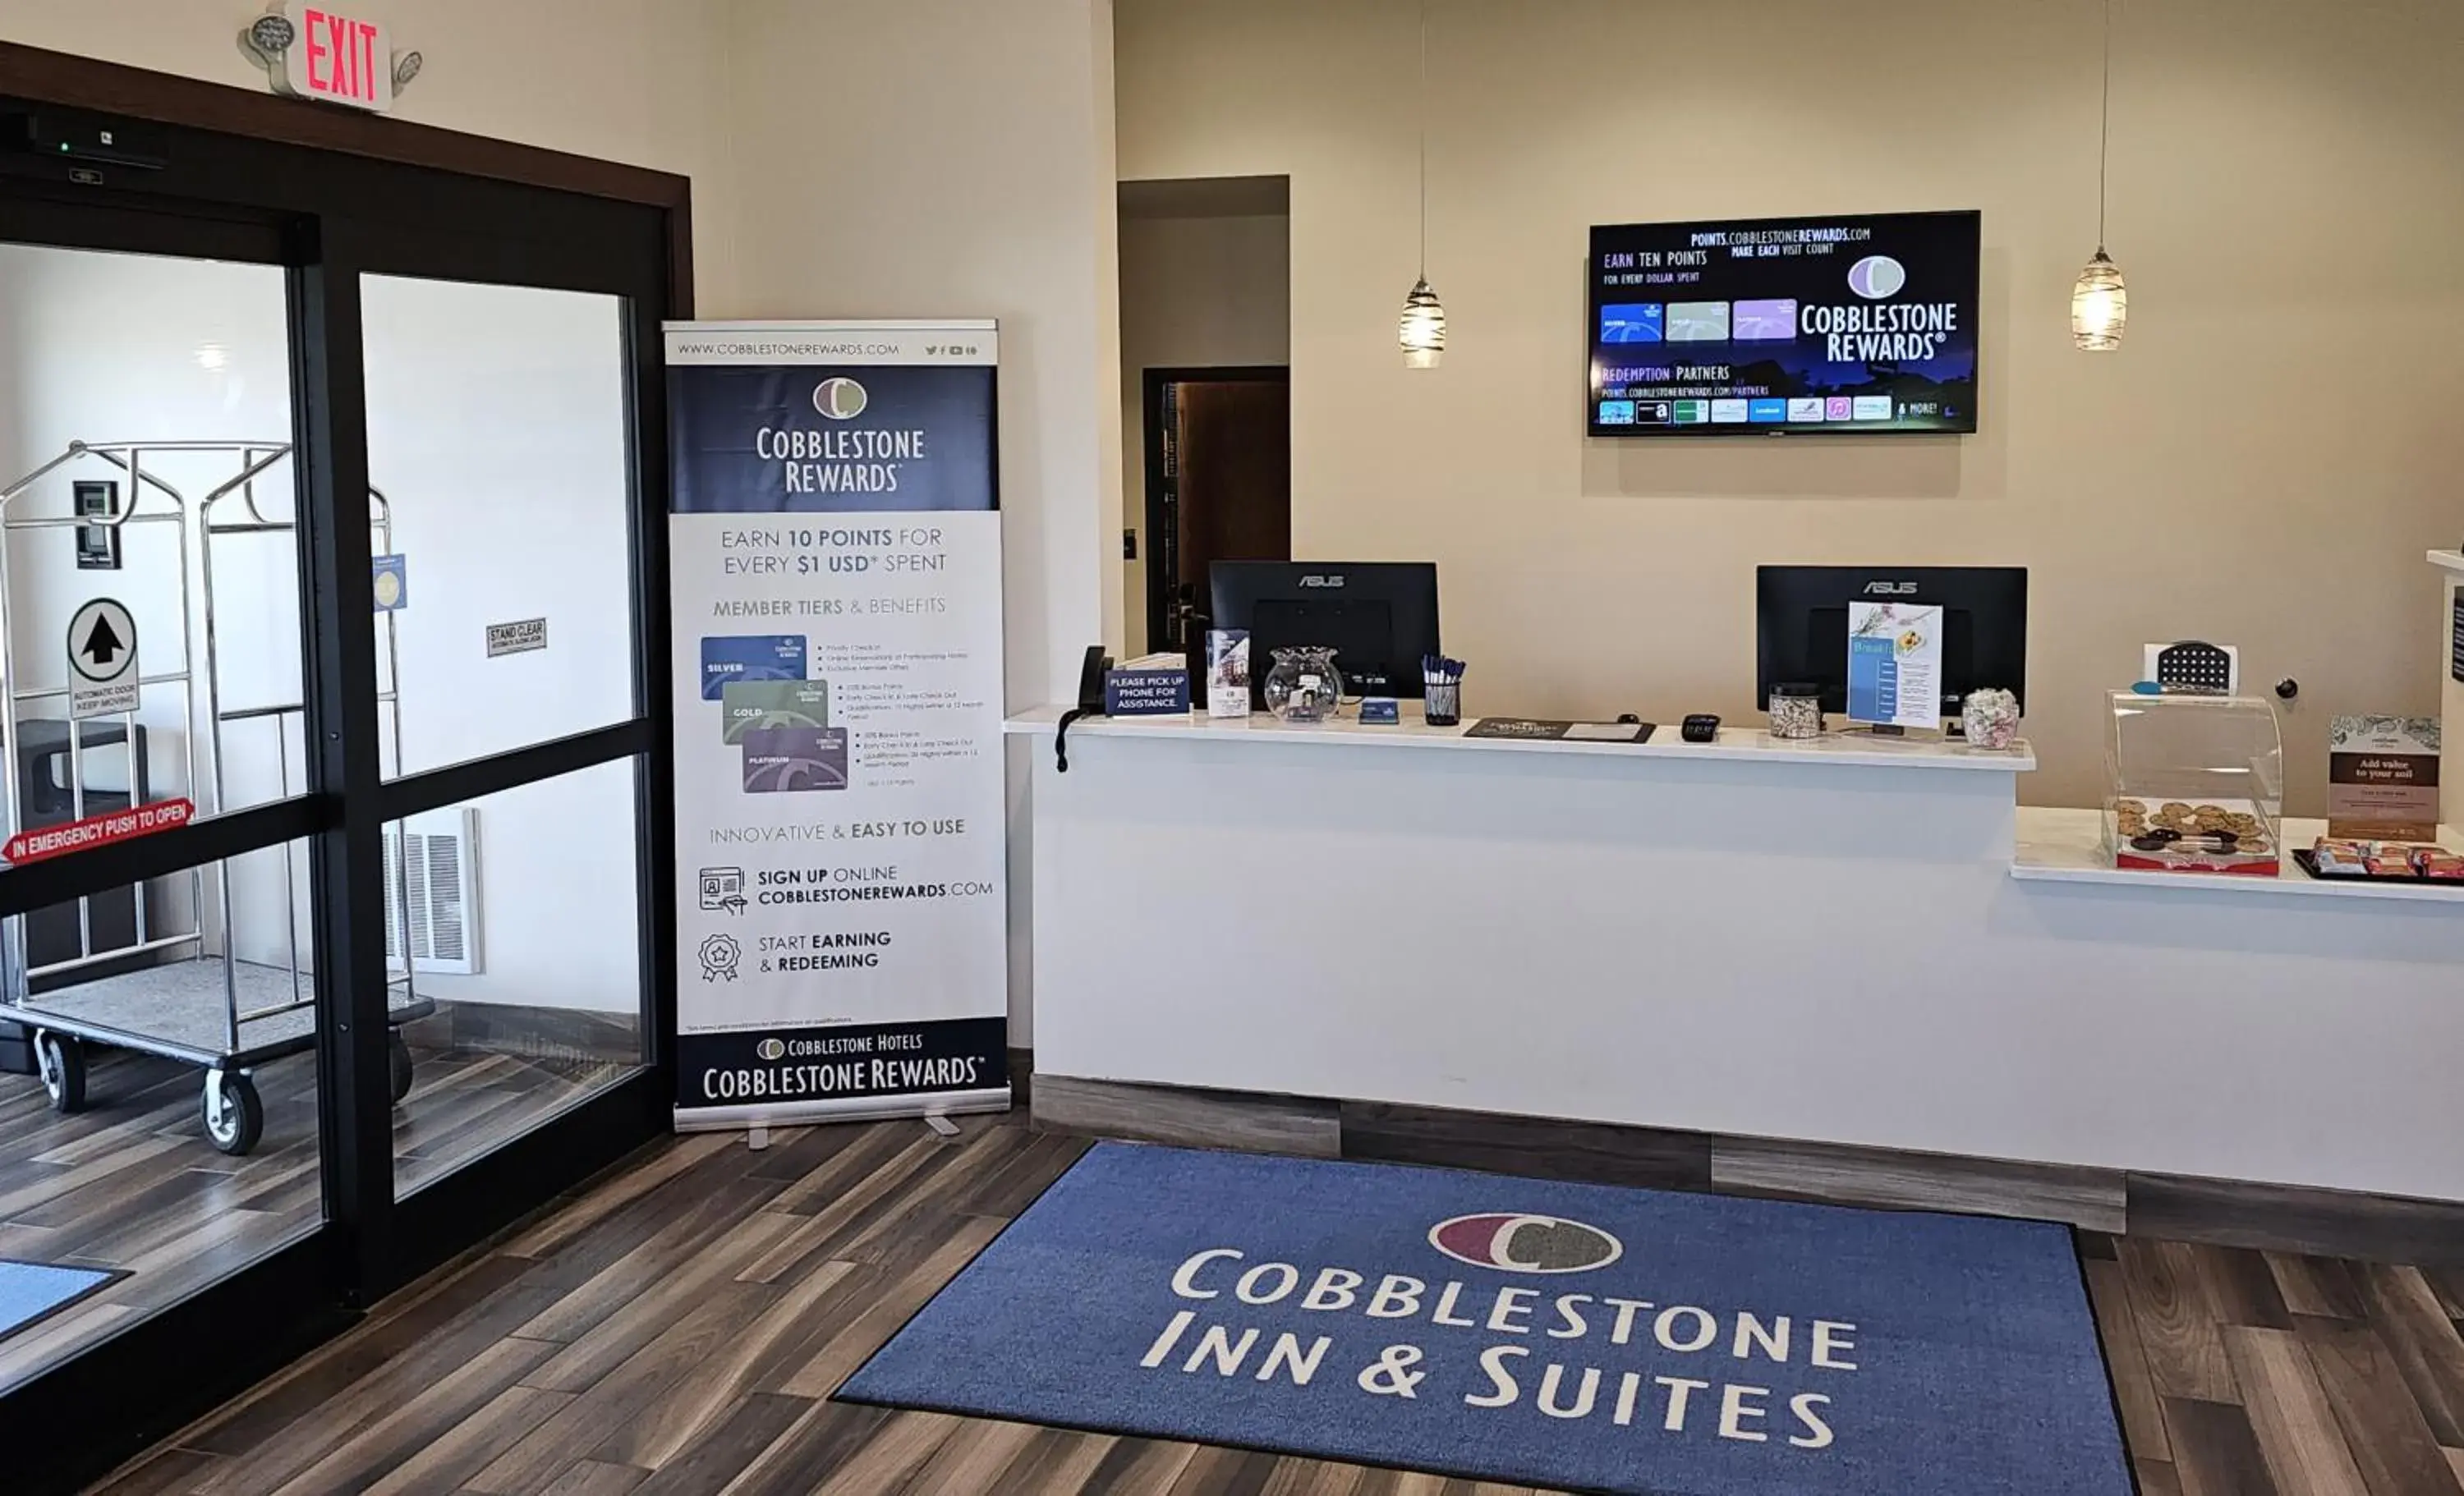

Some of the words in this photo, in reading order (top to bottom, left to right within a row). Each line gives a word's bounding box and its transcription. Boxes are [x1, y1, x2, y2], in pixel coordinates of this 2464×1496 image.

[306, 9, 376, 101] EXIT
[1691, 228, 1870, 246] POINTS.COBBLESTONEREWARDS.COM
[1604, 253, 1634, 268] EARN
[1639, 252, 1661, 267] TEN
[1667, 250, 1708, 266] POINTS
[1731, 246, 1754, 258] MAKE
[1758, 246, 1780, 256] EACH
[1782, 245, 1802, 255] VISIT
[1806, 243, 1834, 254] COUNT
[1604, 275, 1618, 285] FOR
[1620, 273, 1643, 284] EVERY
[1646, 273, 1673, 283] DOLLAR
[1676, 272, 1700, 282] SPENT
[1801, 303, 1957, 334] COBBLESTONE
[678, 343, 899, 356] WWW.COBBLESTONEREWARDS.COM
[1602, 367, 1670, 382] REDEMPTION
[1676, 365, 1730, 380] PARTNERS
[756, 427, 924, 460] COBBLESTONE
[722, 531, 779, 548] EARN
[789, 530, 811, 547] 10
[819, 530, 892, 546] POINTS
[899, 528, 942, 546] FOR
[725, 557, 789, 574] EVERY
[798, 555, 820, 575] $1
[885, 554, 946, 571] SPENT
[1299, 576, 1345, 587] ASUS
[1863, 581, 1918, 594] ASUS
[713, 599, 792, 617] MEMBER
[798, 599, 844, 615] TIERS
[850, 599, 862, 614] &
[870, 597, 946, 614] BENEFITS
[490, 626, 516, 641] STAND
[517, 622, 543, 637] CLEAR
[707, 663, 743, 672] SILVER
[1110, 677, 1144, 687] PLEASE
[1148, 677, 1169, 686] PICK
[1171, 676, 1185, 686] UP
[1119, 688, 1154, 697] PHONE
[1156, 687, 1176, 696] FOR
[733, 709, 763, 717] GOLD
[2360, 759, 2379, 769] Add
[2382, 760, 2409, 769] value
[2370, 770, 2391, 779] your
[2395, 770, 2413, 778] soil
[13, 839, 25, 858] IN
[29, 825, 104, 855] EMERGENCY
[106, 815, 137, 836] PUSH
[139, 811, 154, 828] TO
[157, 804, 186, 824] OPEN
[710, 825, 825, 844] INNOVATIVE
[833, 826, 845, 838] &
[852, 822, 895, 838] EASY
[903, 820, 927, 836] TO
[933, 819, 965, 835] USE
[758, 870, 802, 886] SIGN
[807, 869, 828, 883] UP
[834, 865, 898, 881] ONLINE
[758, 881, 994, 905] COBBLESTONEREWARDS.COM
[760, 935, 806, 951] START
[812, 932, 891, 949] EARNING
[761, 960, 771, 972] &
[779, 953, 879, 971] REDEEMING
[788, 1039, 872, 1057] COBBLESTONE
[878, 1034, 924, 1050] HOTELS
[703, 1062, 867, 1100] COBBLESTONE
[1170, 1248, 1859, 1370] COBBLESTONE
[1139, 1310, 1331, 1385] INN
[1357, 1343, 1427, 1398] &
[1464, 1344, 1837, 1448] SUITES
